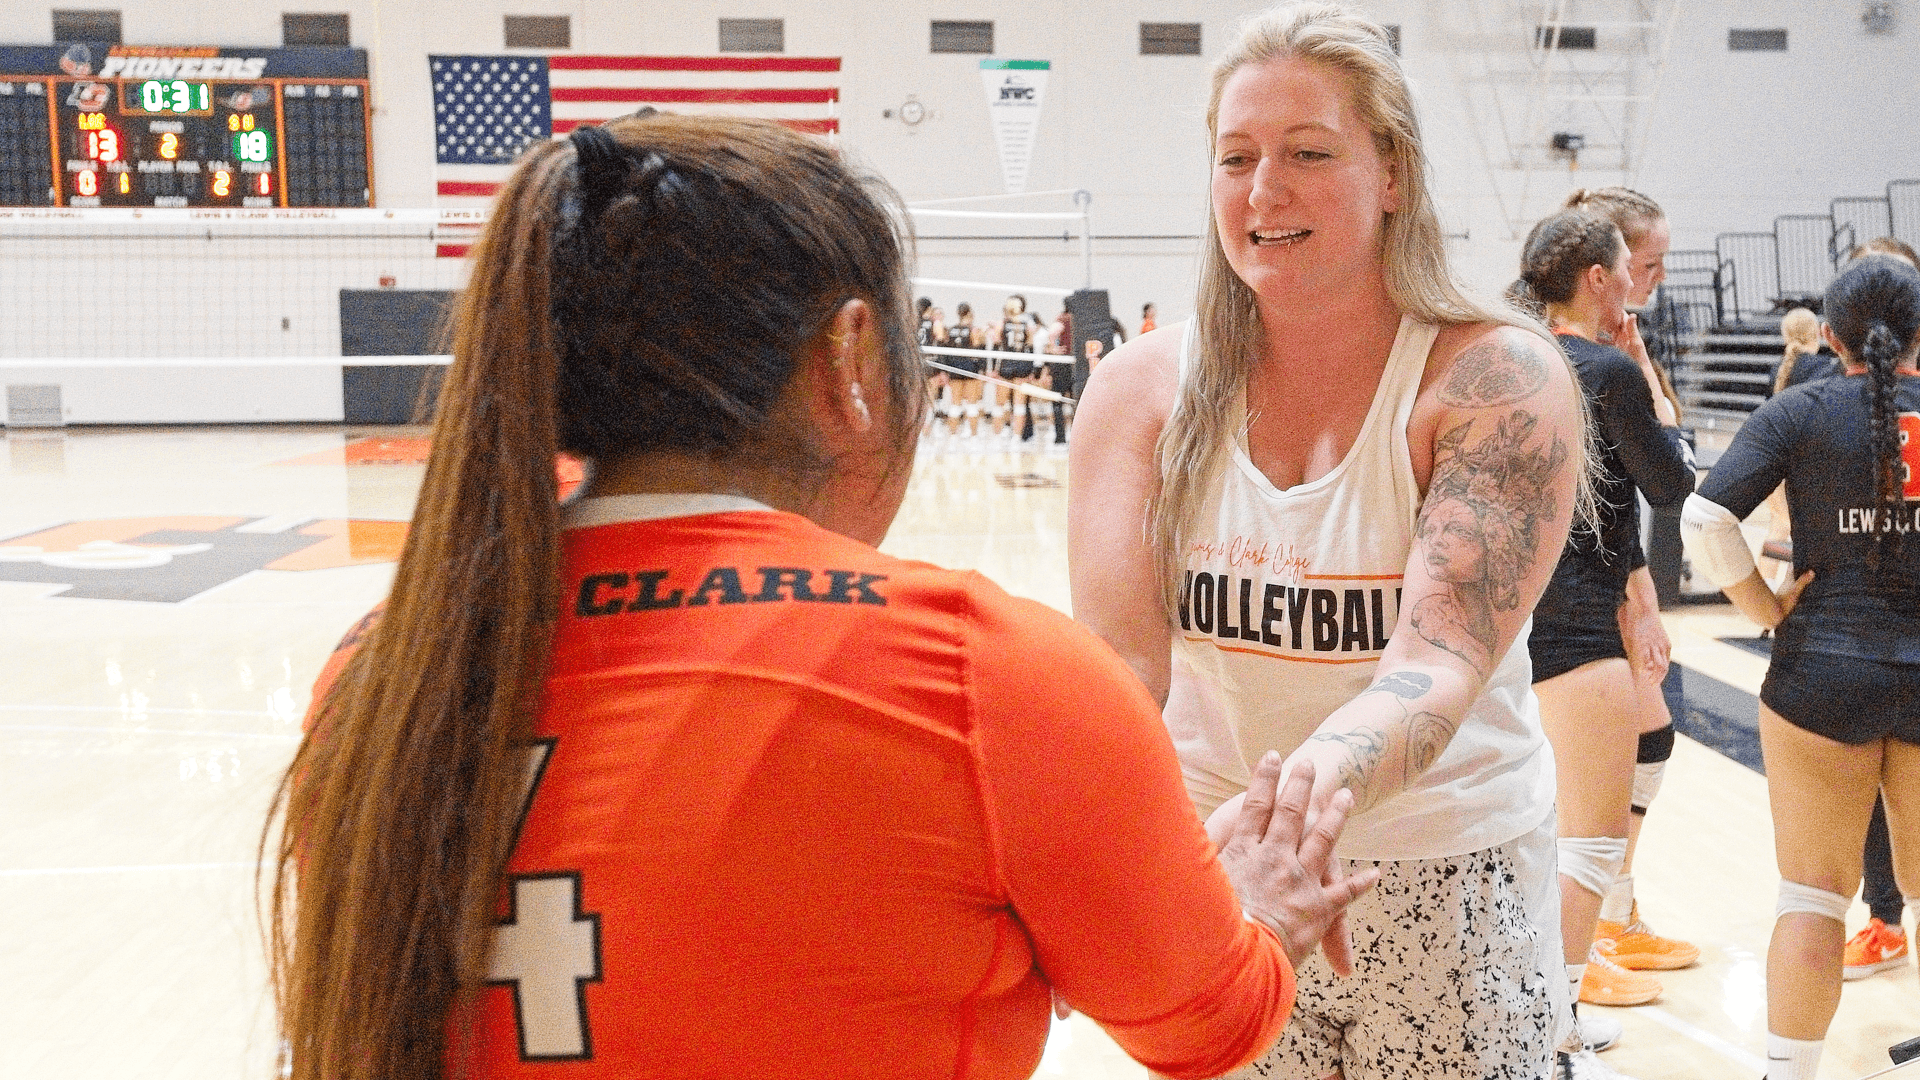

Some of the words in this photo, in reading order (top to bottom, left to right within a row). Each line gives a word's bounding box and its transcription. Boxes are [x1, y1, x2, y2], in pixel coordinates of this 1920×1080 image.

[99, 56, 268, 80] PIONEERS
[142, 80, 210, 113] 0:31
[88, 129, 118, 162] 13
[160, 132, 178, 159] 2
[239, 130, 268, 162] 18
[78, 169, 97, 196] 0
[119, 171, 130, 194] 1
[213, 169, 231, 196] 2
[259, 172, 270, 195] 1
[1838, 508, 1892, 534] LEWS
[575, 566, 889, 618] CLARK
[1177, 569, 1402, 652] VOLLEYBAL
